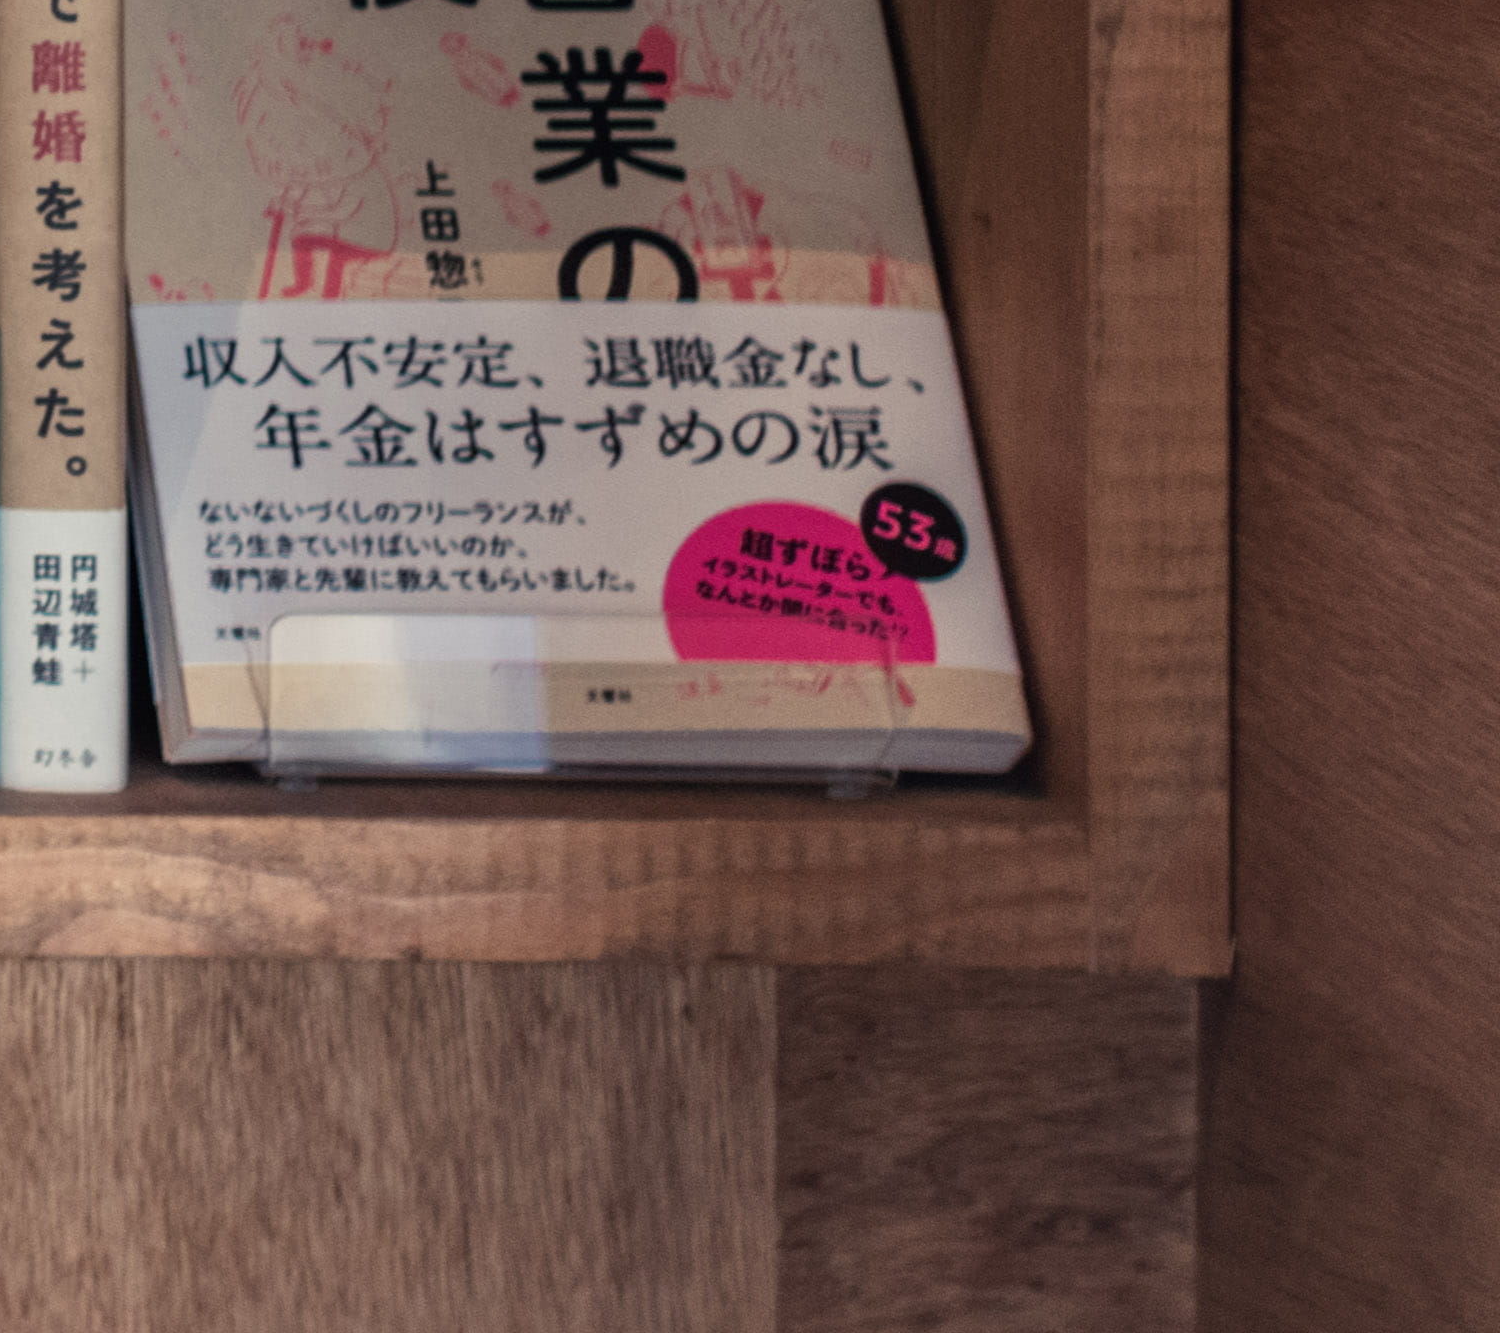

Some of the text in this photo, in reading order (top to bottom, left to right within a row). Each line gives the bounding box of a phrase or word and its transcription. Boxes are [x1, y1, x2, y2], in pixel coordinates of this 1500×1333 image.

[182, 333, 928, 397] 収入不安定、退職金なし、
[254, 401, 896, 474] 年金はすずめの涙
[198, 499, 587, 526] ないないづくしのフリーランスが、
[872, 499, 958, 563] 53歳
[203, 533, 530, 560] どう生きていけばいいのか、
[740, 527, 873, 582] 超ずぼら
[209, 566, 637, 594] 専門家と先輩に教えてもらいました。
[31, 554, 62, 686] 田辺青蛙
